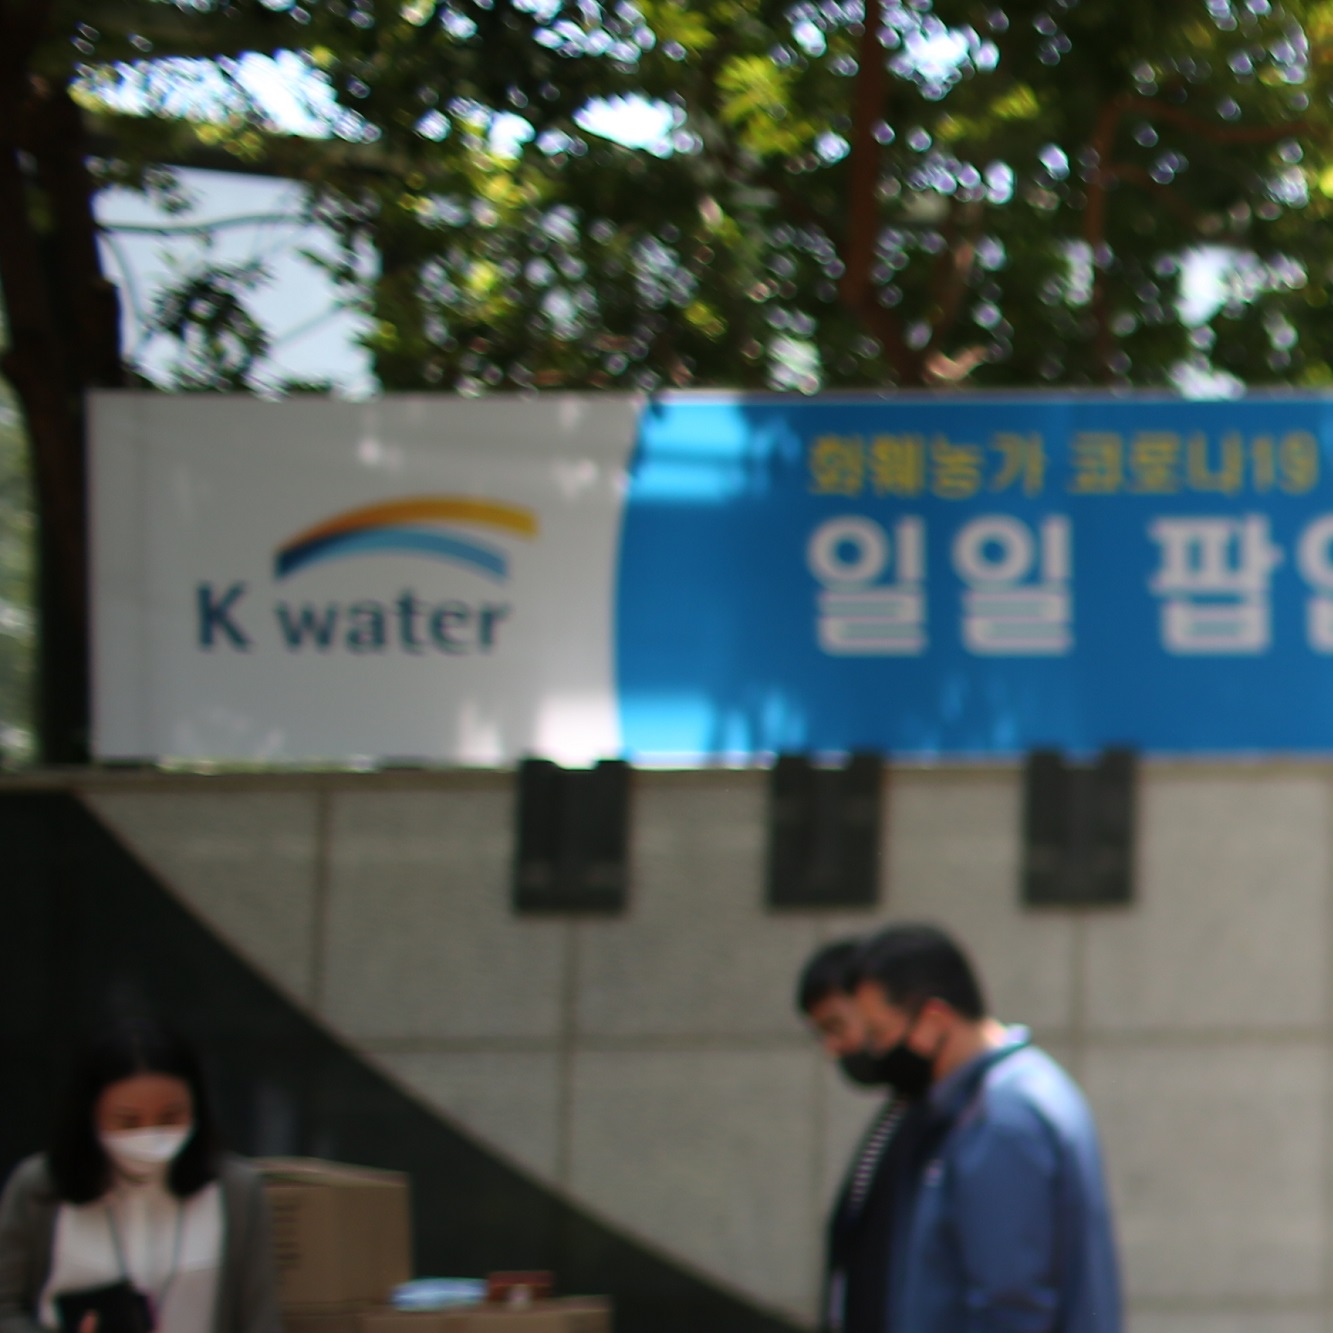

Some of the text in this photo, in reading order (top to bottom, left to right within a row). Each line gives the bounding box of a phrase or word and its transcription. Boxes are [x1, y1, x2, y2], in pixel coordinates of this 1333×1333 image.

[1069, 429, 1319, 496] 코로나19
[195, 581, 510, 655] K water
[808, 513, 1074, 655] 일일
